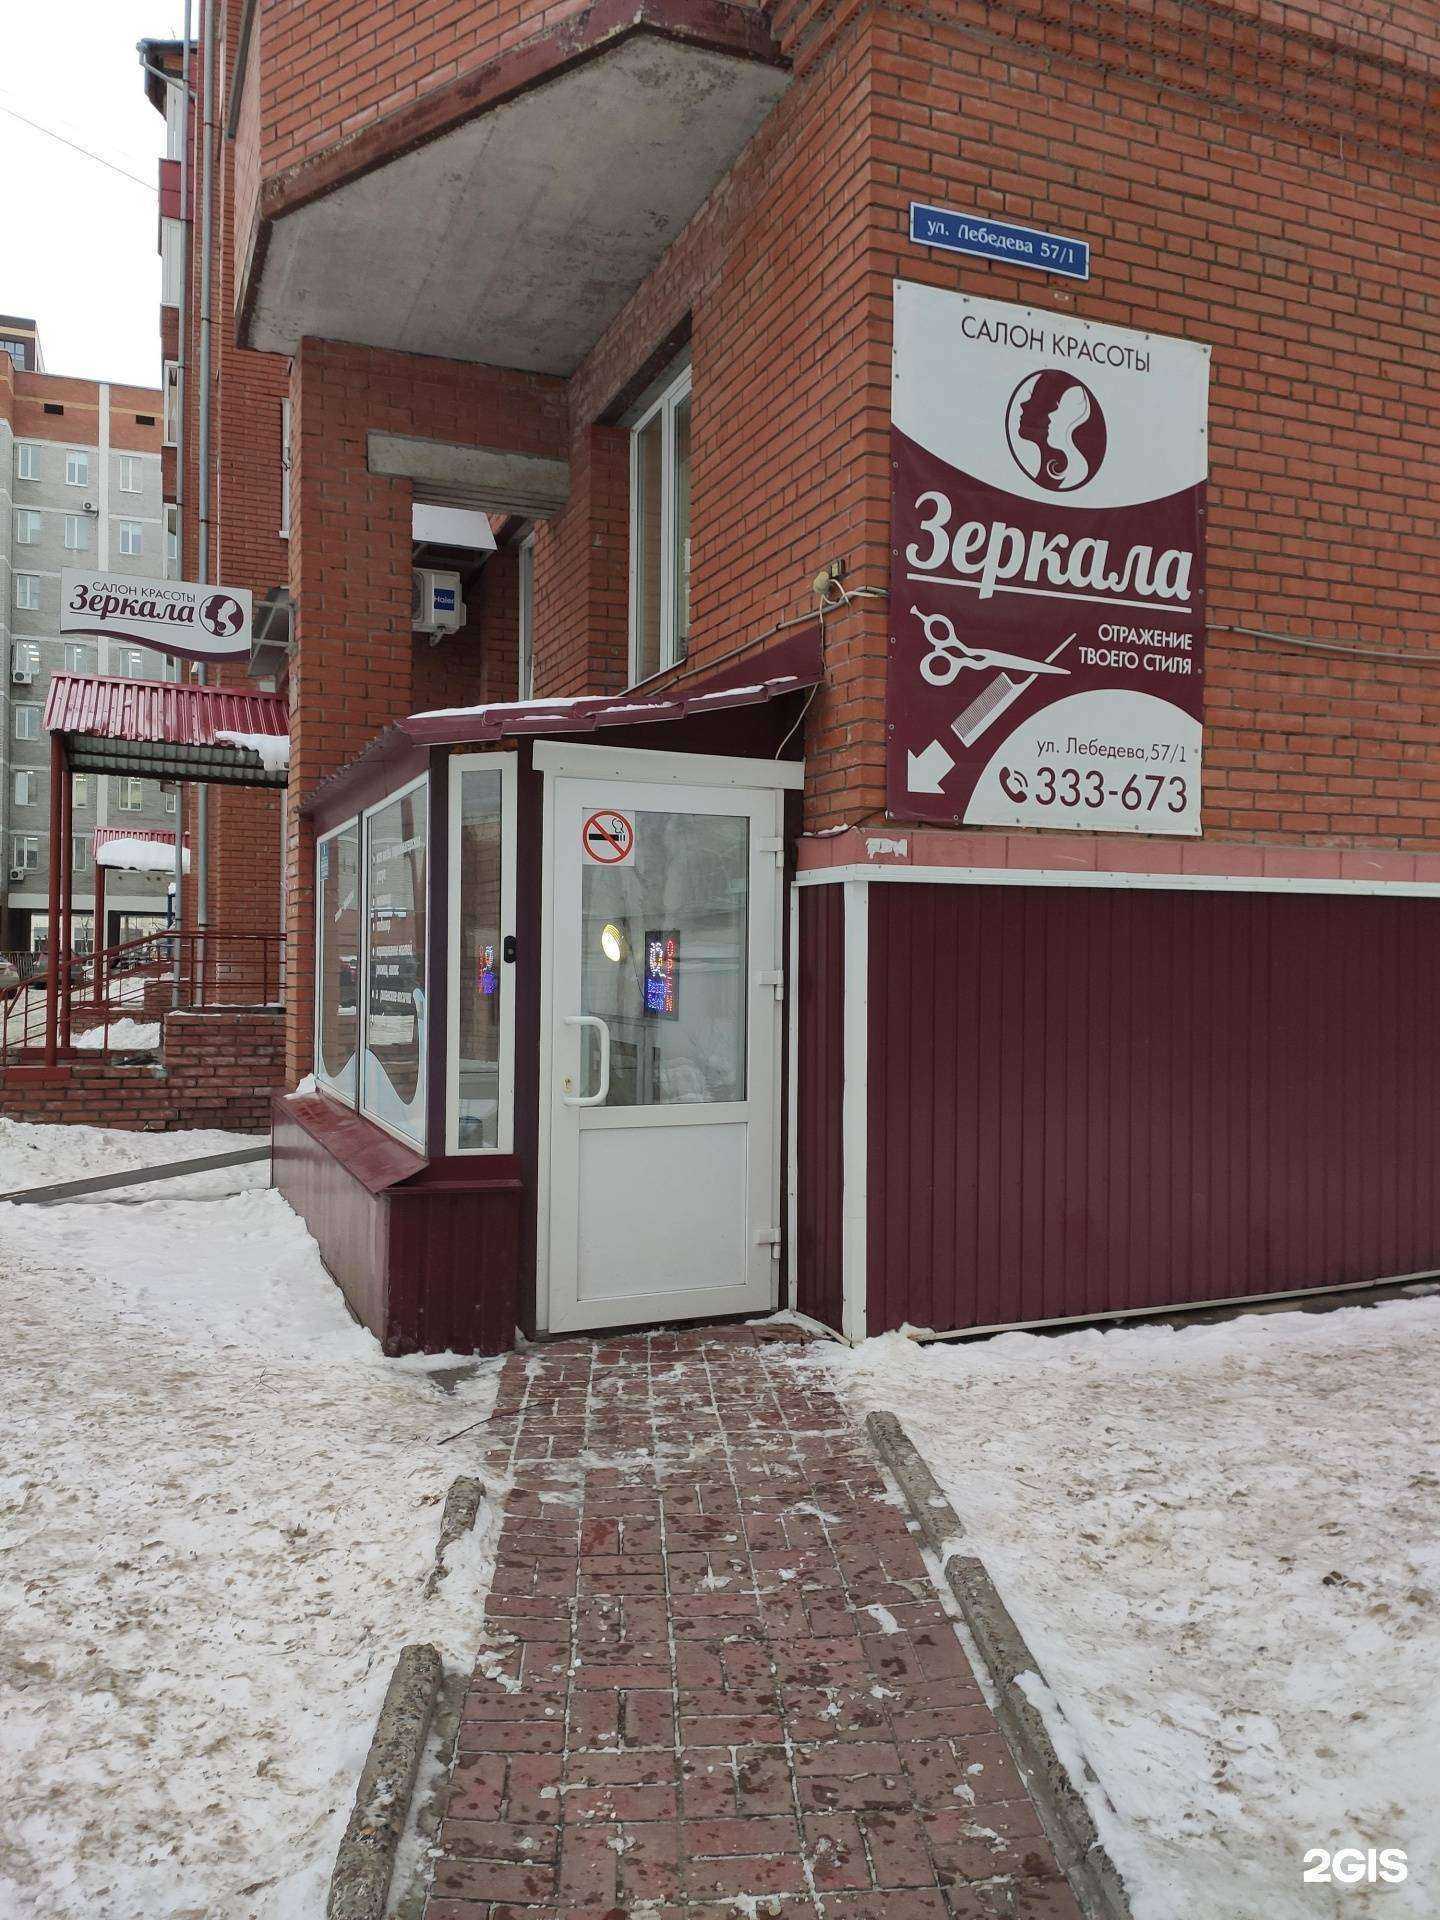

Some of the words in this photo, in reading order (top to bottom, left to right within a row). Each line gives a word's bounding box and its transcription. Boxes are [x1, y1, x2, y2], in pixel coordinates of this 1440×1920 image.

[926, 220, 950, 236] ул.
[957, 224, 1034, 255] Лебедева
[1040, 242, 1075, 264] 57/1
[961, 315, 1045, 352] САЛОН
[1052, 333, 1151, 373] КРАСОТЫ
[904, 489, 1194, 601] Зеркала
[69, 584, 195, 623] Зеркала
[92, 581, 137, 596] САЛОН
[141, 587, 196, 603] КРАСОТЫ
[434, 595, 454, 604] Haier
[1097, 623, 1194, 652] ОТРАЖЕНИЕ
[1078, 646, 1139, 669] ТВОЕГО
[1142, 652, 1192, 675] СТИЛЯ
[1036, 738, 1060, 757] ул.
[1066, 736, 1187, 763] Лебедева,57/1
[1034, 766, 1189, 814] 333-673
